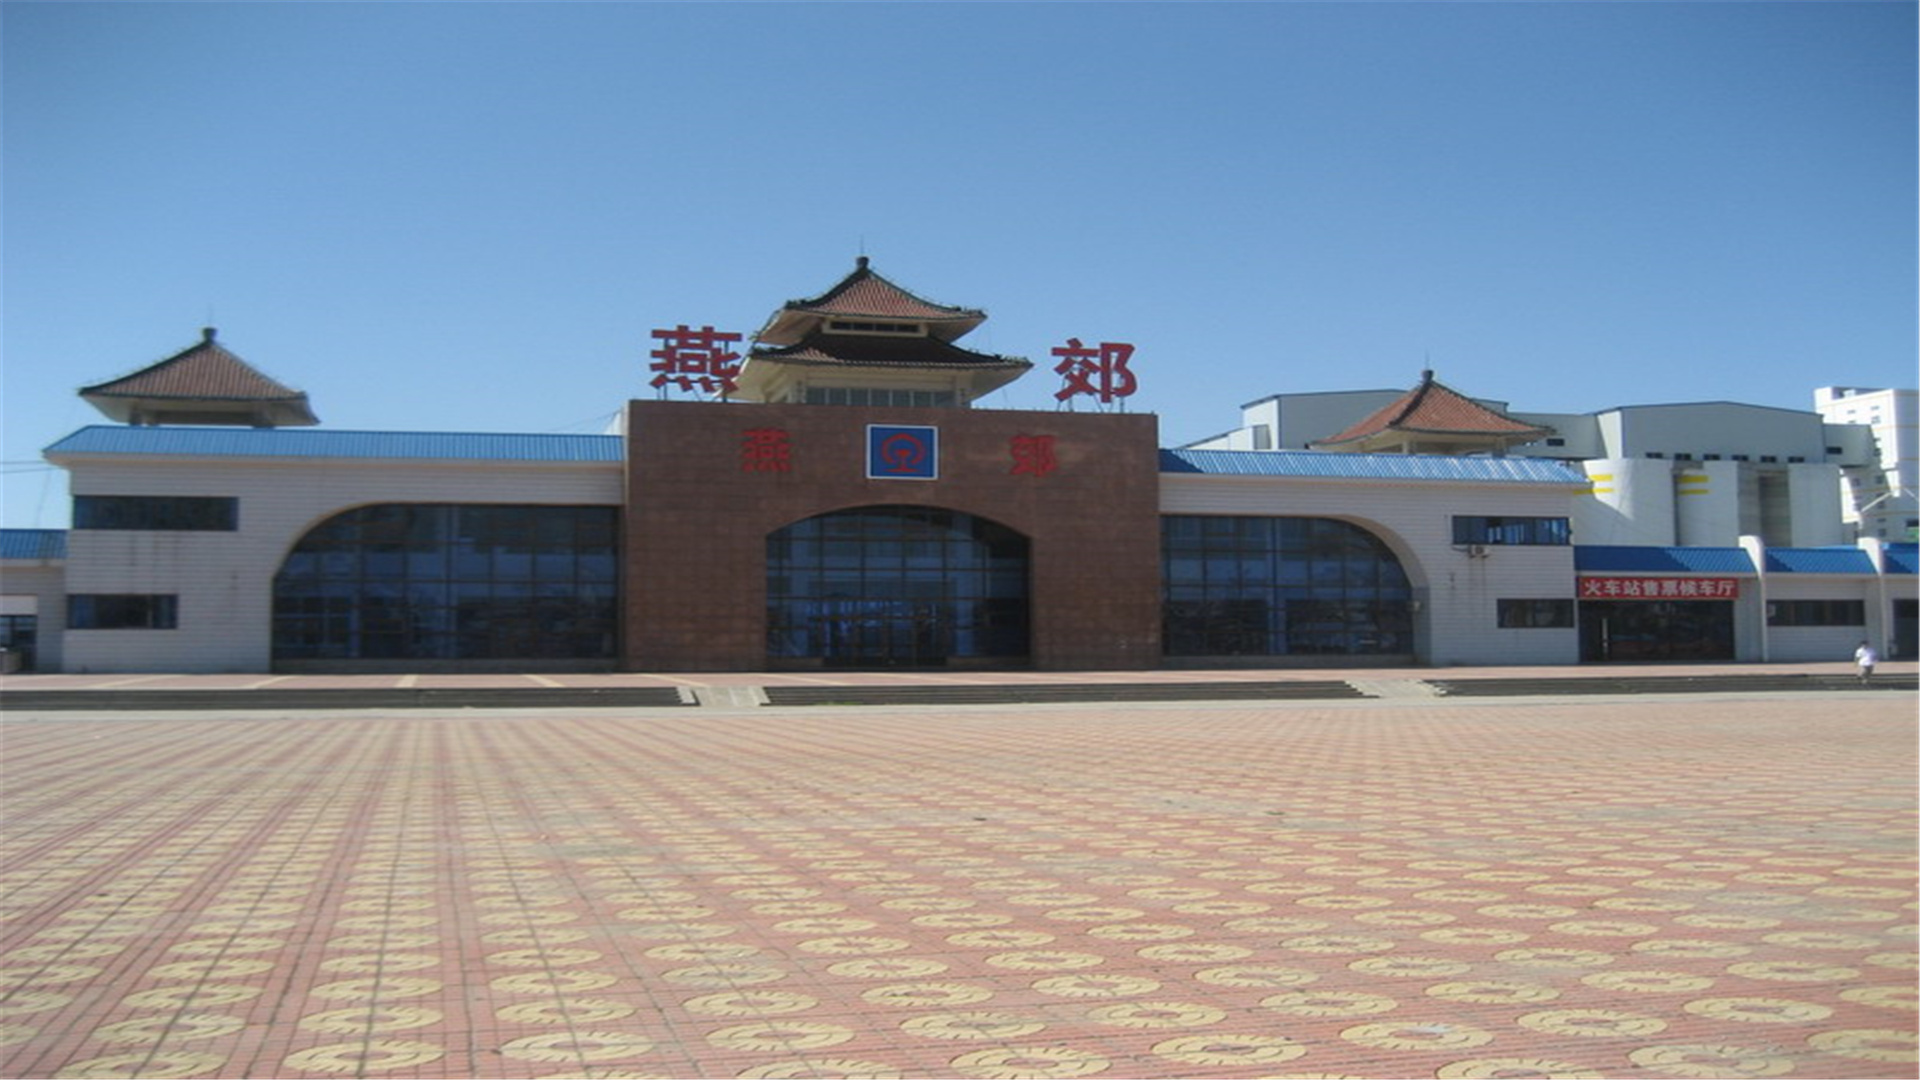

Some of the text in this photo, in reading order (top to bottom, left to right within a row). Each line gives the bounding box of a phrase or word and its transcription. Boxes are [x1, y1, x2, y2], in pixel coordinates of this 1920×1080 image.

[649, 325, 1137, 403] 燕 郊
[742, 428, 1057, 477] 燕 郊
[1584, 579, 1736, 597] 火车站售票候车厅
